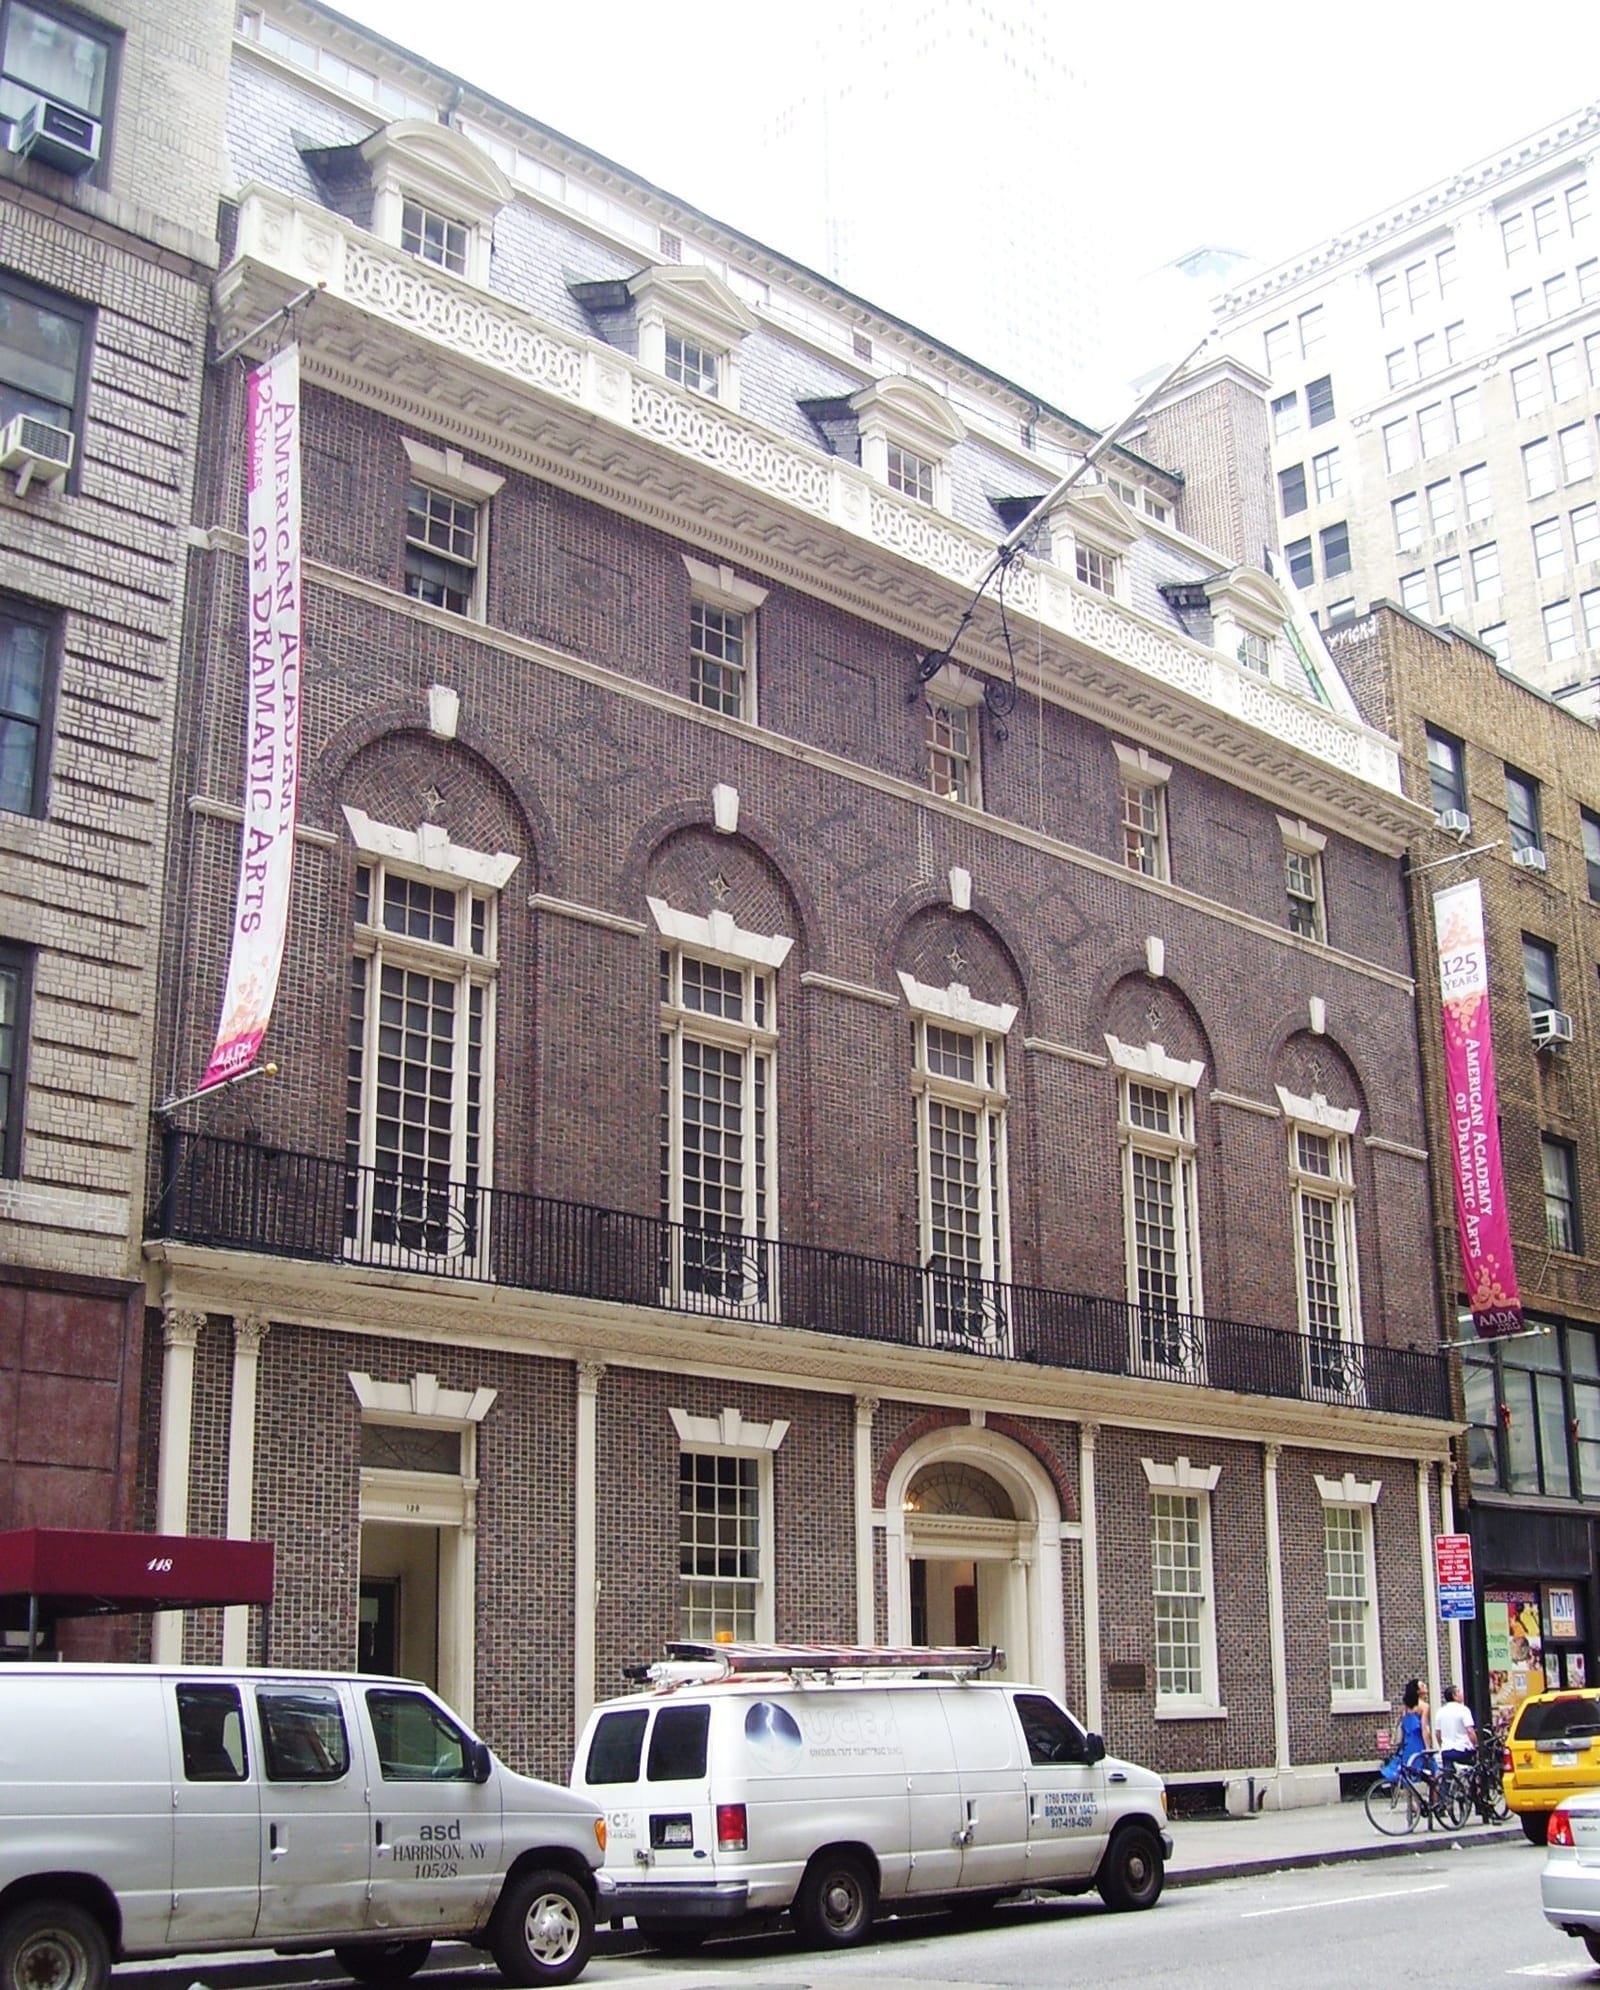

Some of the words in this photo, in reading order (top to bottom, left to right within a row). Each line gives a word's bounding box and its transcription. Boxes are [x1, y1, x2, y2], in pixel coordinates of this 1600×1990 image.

[274, 401, 296, 613] AMERICAN
[253, 526, 268, 572] OF
[251, 585, 276, 813] DRAMATIC
[240, 827, 274, 934] ARTS
[1442, 952, 1478, 977] 125
[1444, 973, 1480, 991] YEARS
[1465, 1039, 1485, 1126] AMERICAN
[1456, 1093, 1467, 1113] OF
[1456, 1118, 1476, 1209] DRAMATIC
[1473, 1131, 1493, 1216] ACADEMY
[1466, 1214, 1482, 1258] ARTS
[1480, 1310, 1518, 1326] AADA
[1550, 1592, 1574, 1618] TASTY
[1045, 1805, 1067, 1816] BRONX
[1068, 1806, 1077, 1815] NY
[1061, 1793, 1081, 1803] STORY
[420, 1819, 461, 1841] asd
[470, 1843, 487, 1859] NY
[415, 1863, 458, 1879] 10528
